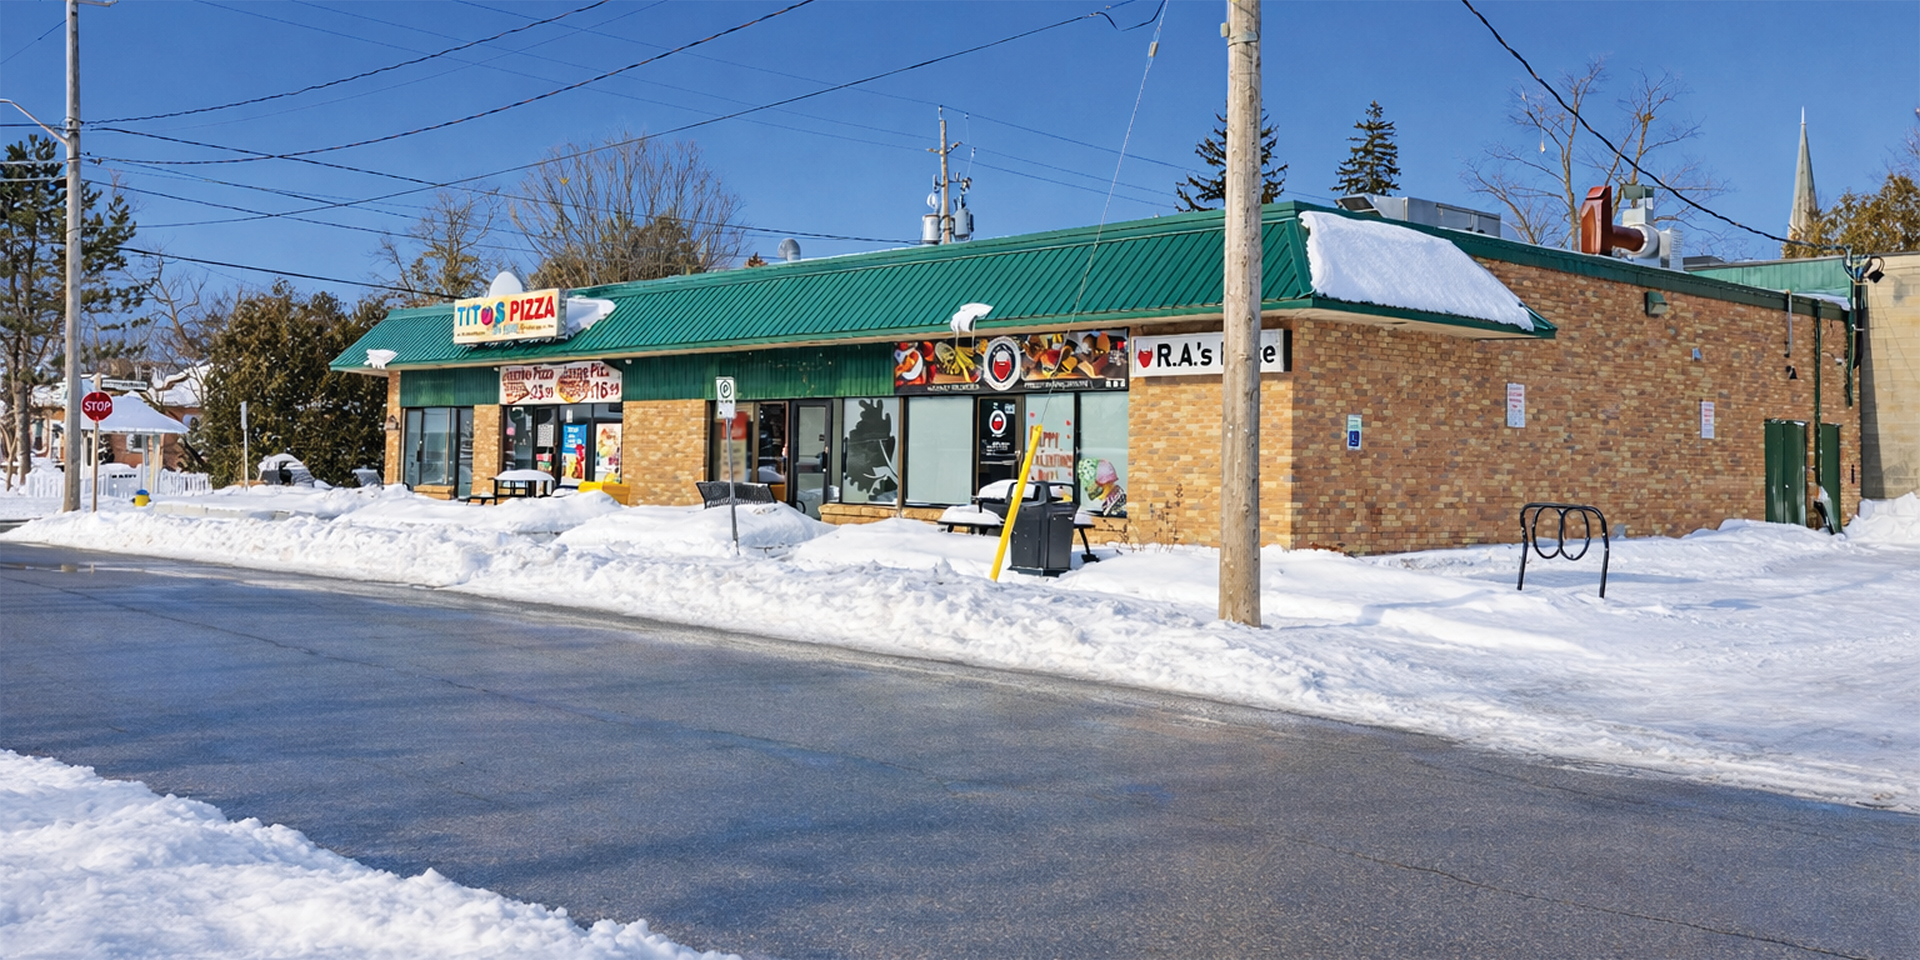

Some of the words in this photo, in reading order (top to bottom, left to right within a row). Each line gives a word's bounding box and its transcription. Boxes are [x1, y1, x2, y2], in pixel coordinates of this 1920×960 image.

[509, 295, 555, 322] PIZZA
[1156, 342, 1212, 368] R.A.'s
[84, 401, 111, 411] STOP
